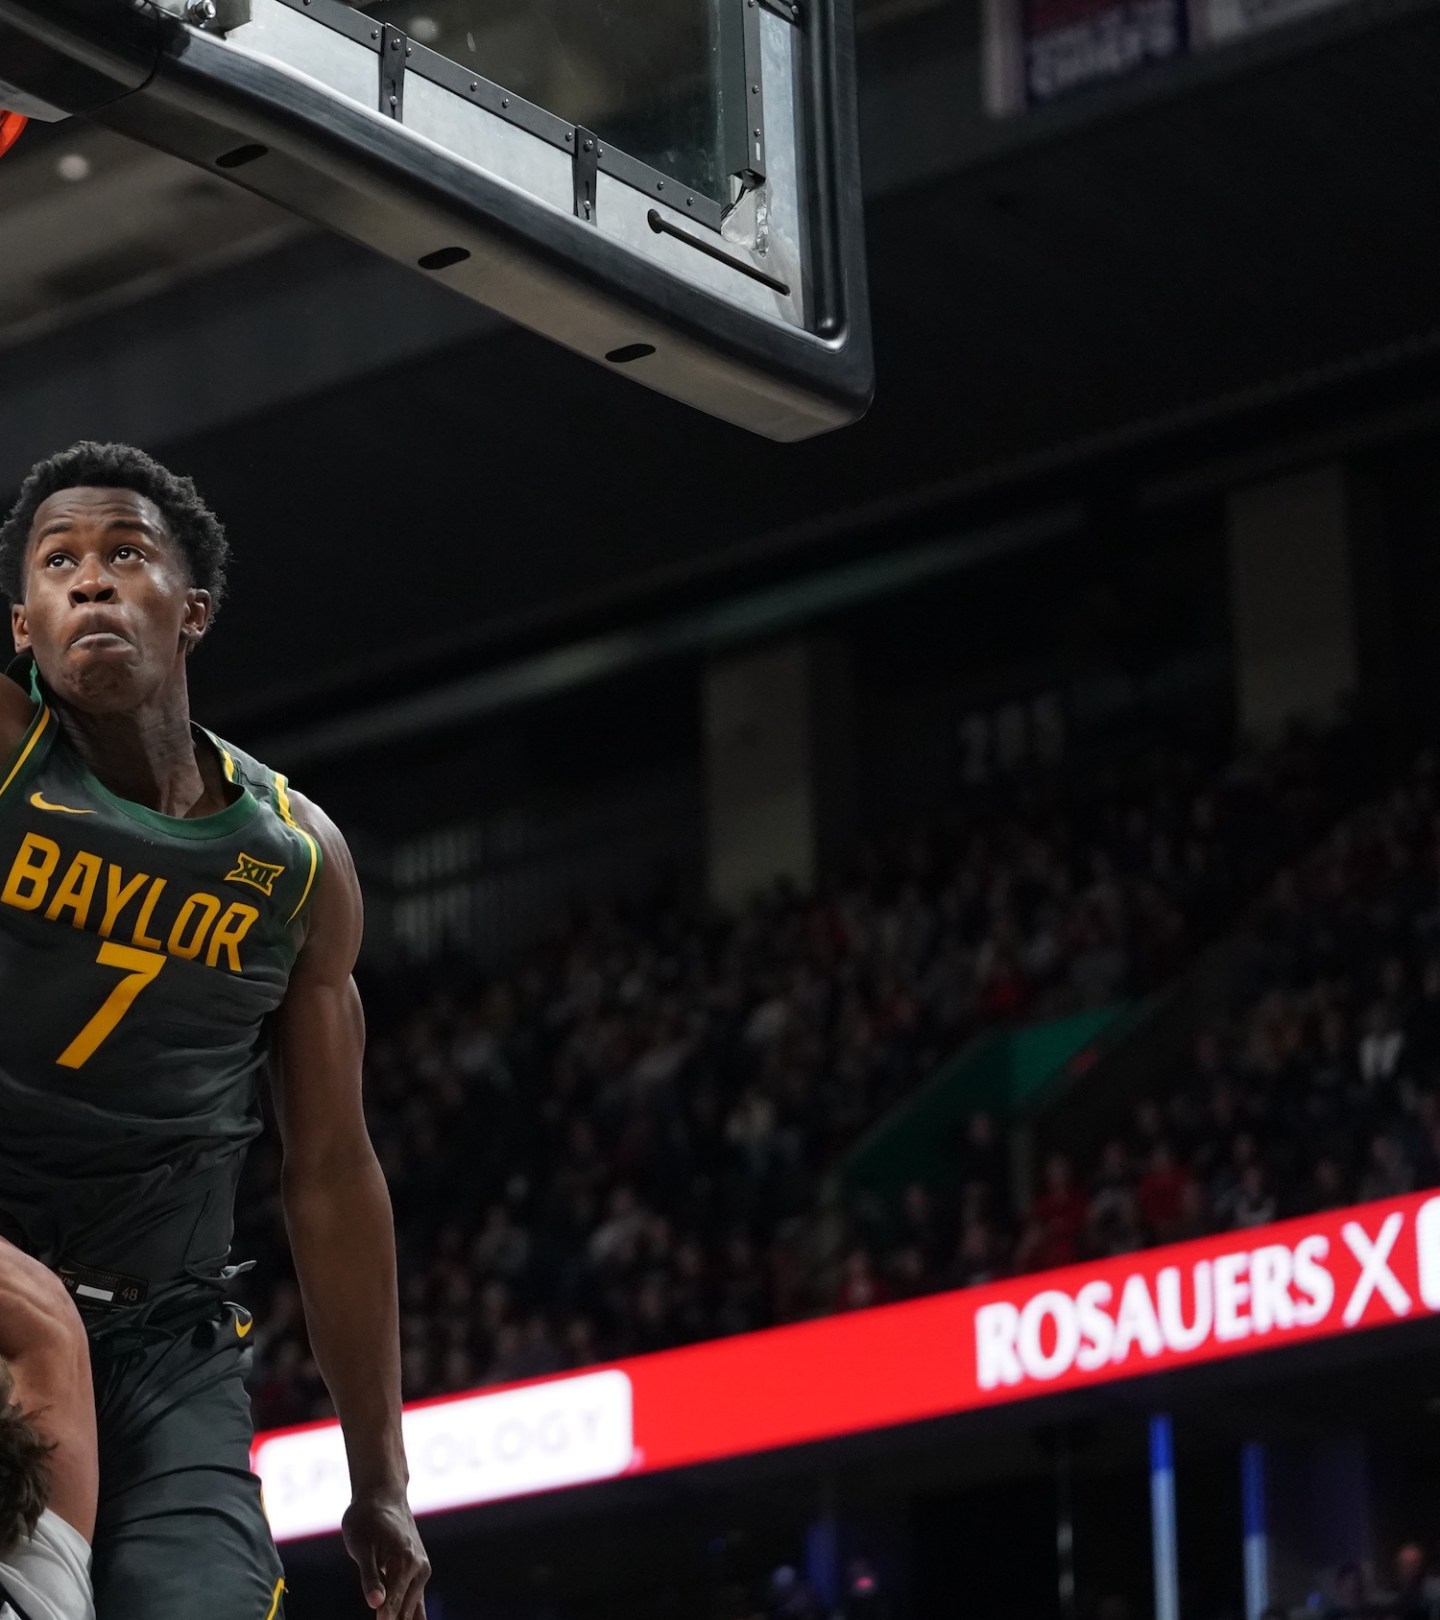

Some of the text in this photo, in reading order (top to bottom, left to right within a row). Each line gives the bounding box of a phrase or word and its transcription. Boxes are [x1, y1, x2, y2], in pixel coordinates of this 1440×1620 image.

[0, 832, 259, 972] BAYLOR
[228, 856, 281, 893] XII
[55, 941, 167, 1069] 7
[121, 1286, 139, 1302] 48
[975, 1234, 1335, 1391] ROSAUERS
[1341, 1211, 1412, 1328] X
